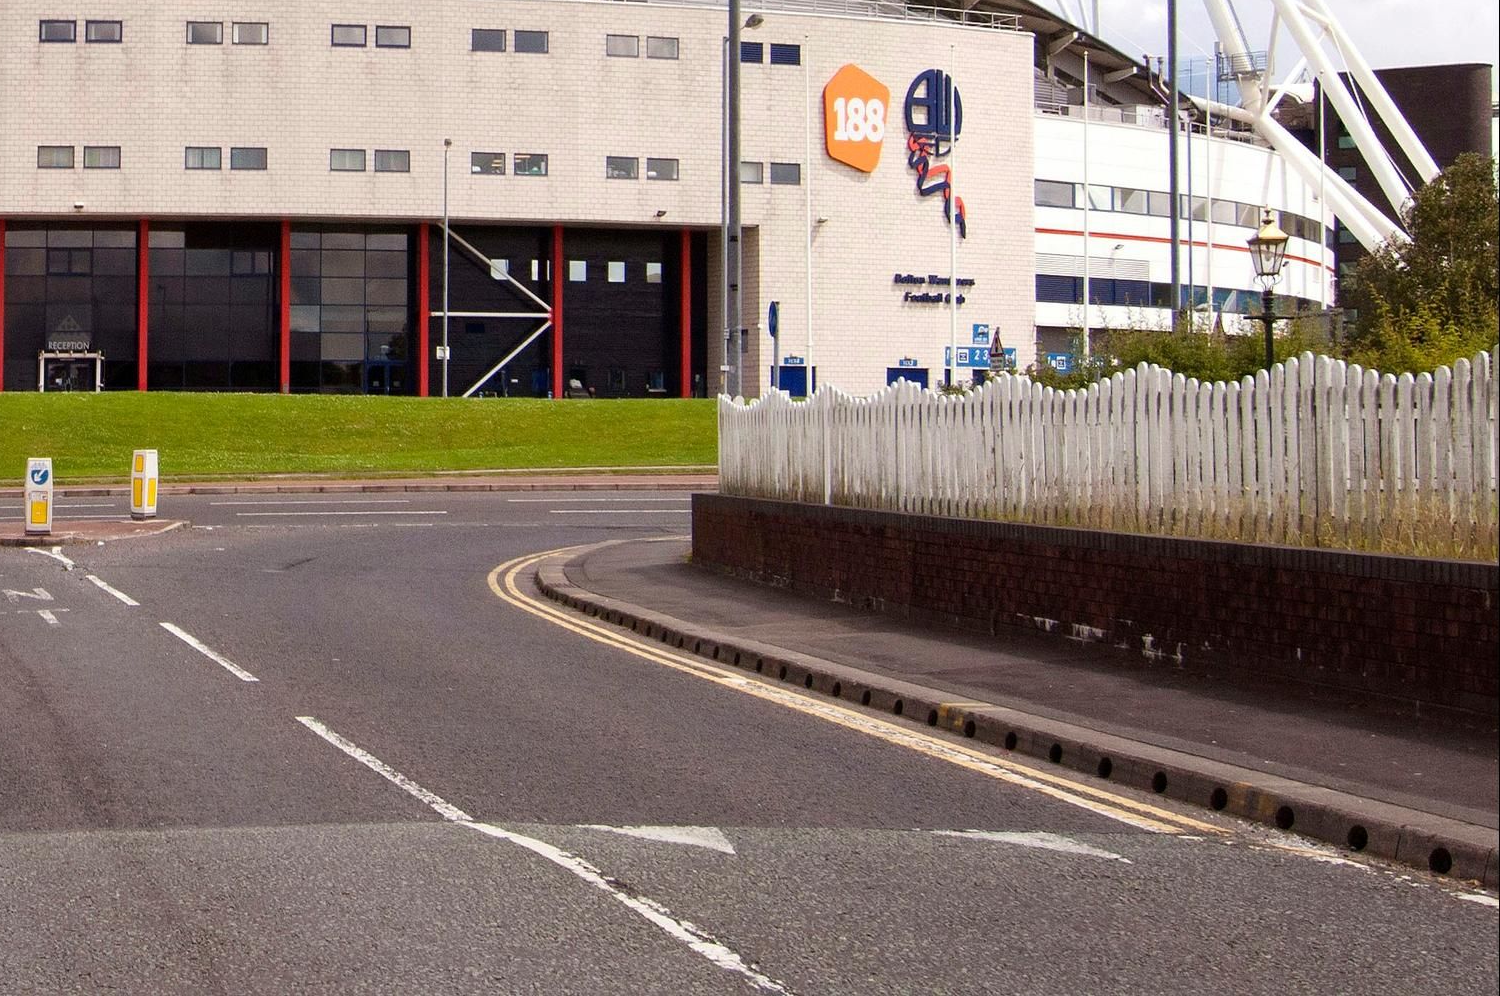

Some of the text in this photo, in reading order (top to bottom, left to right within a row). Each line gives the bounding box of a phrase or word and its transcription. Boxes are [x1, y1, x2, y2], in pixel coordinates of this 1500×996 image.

[834, 97, 885, 143] 188
[944, 293, 966, 304] Cub
[48, 341, 90, 350] RECEPTION
